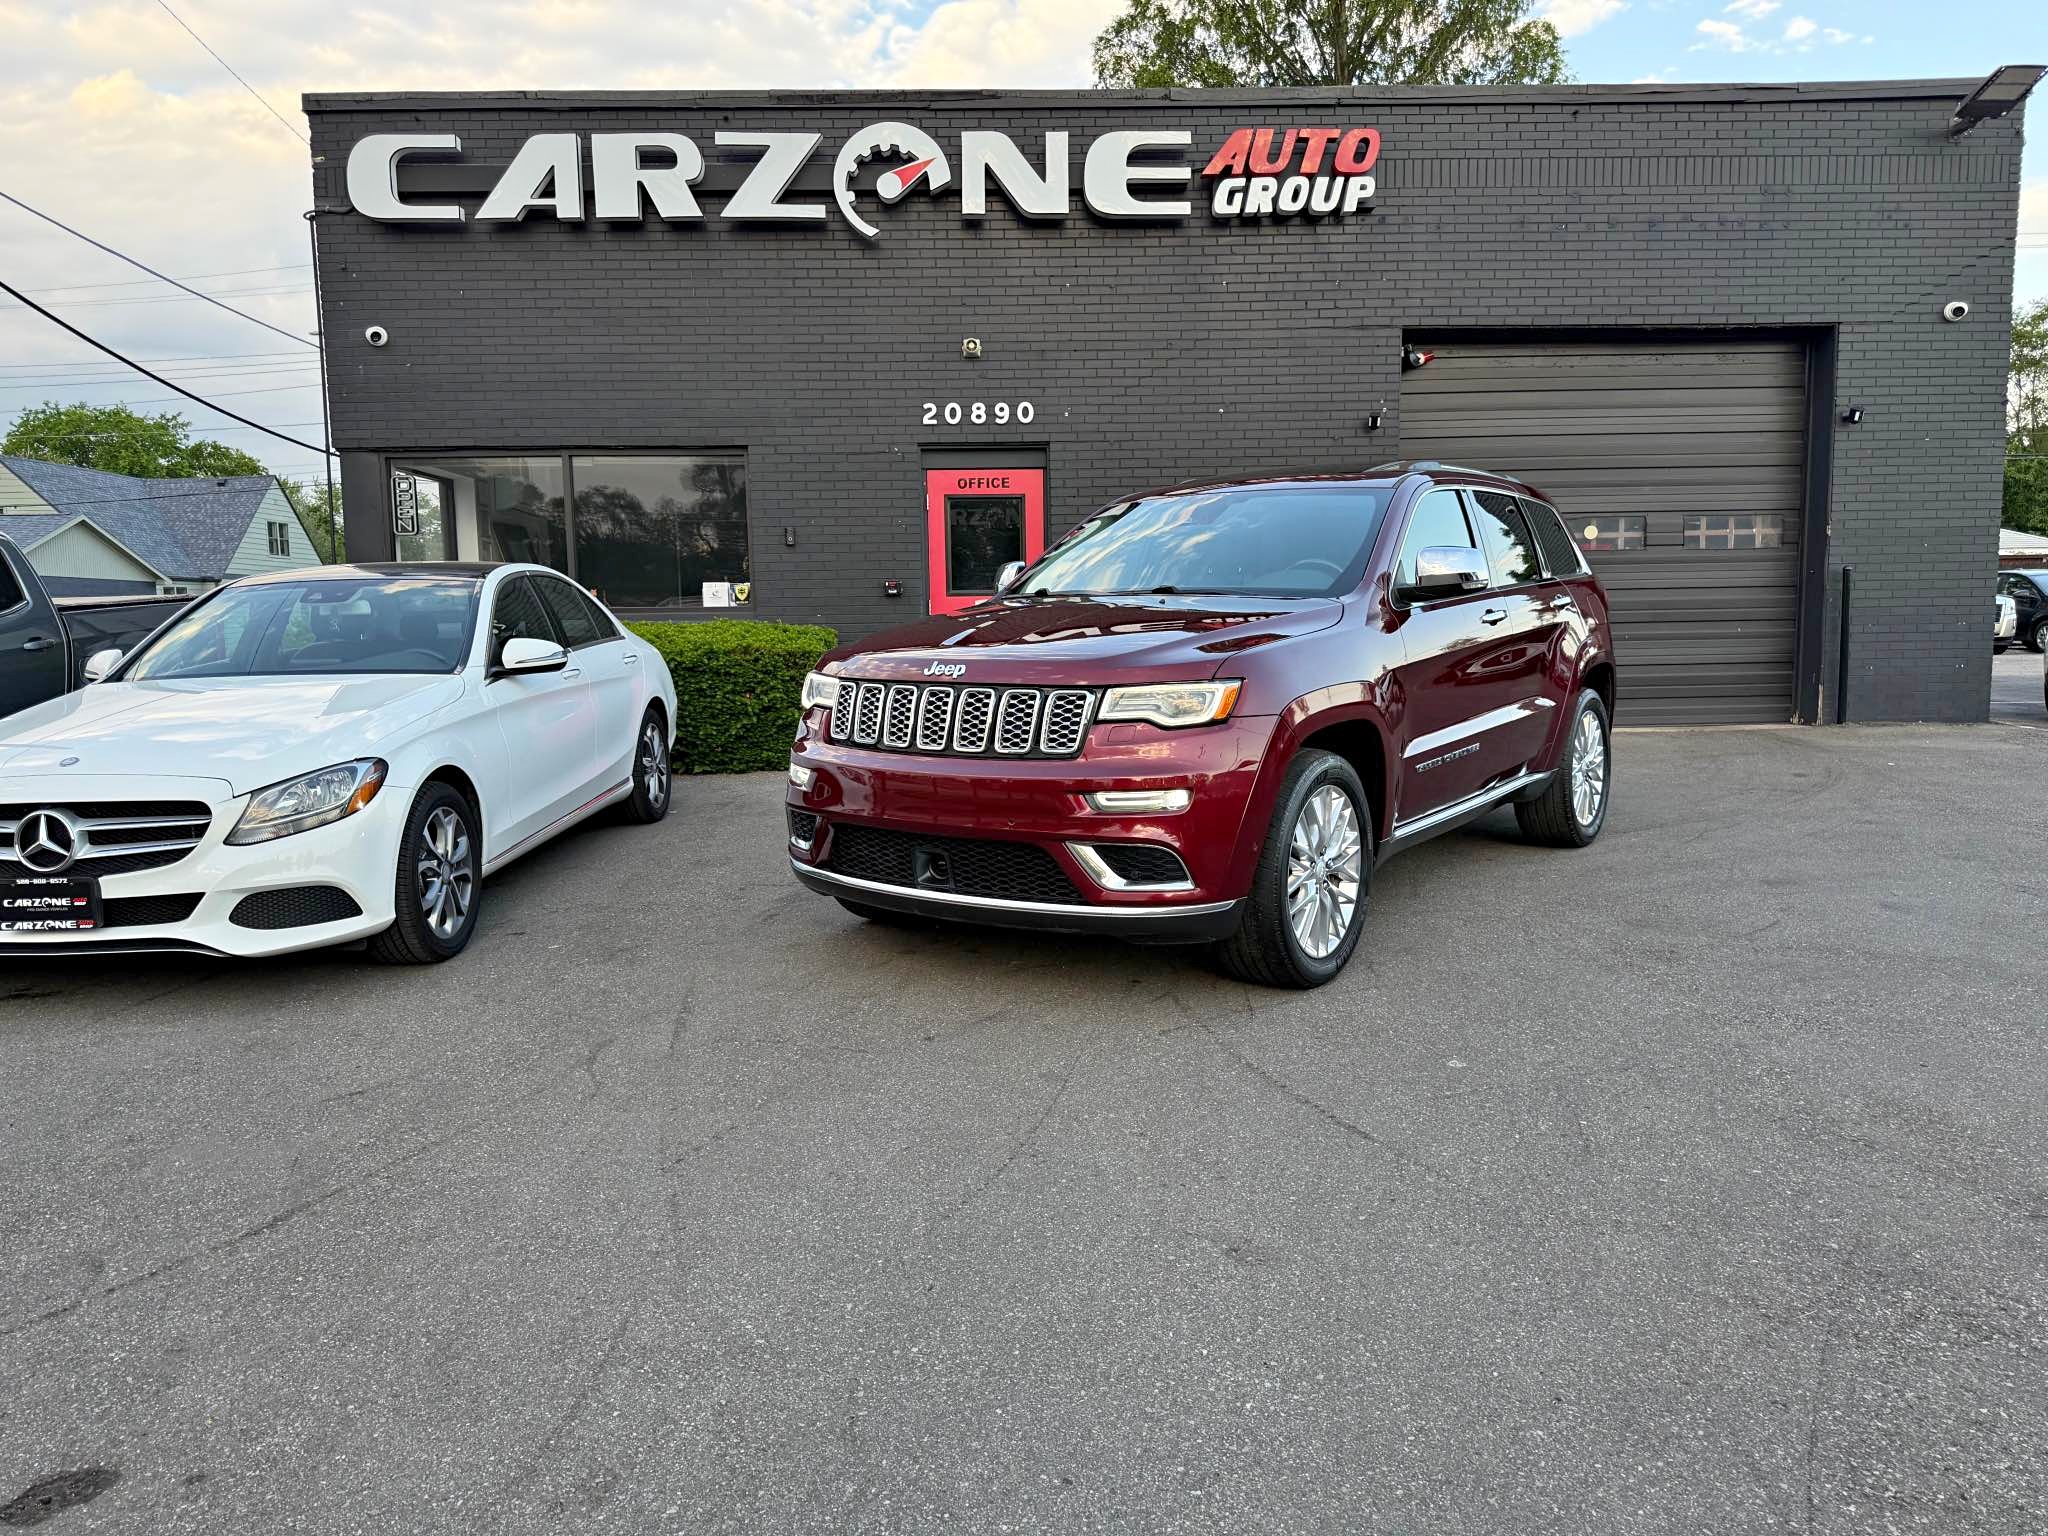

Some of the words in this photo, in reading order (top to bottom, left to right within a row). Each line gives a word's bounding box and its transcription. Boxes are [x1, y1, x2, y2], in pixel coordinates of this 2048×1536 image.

[347, 121, 1191, 238] CARZONE
[1201, 128, 1381, 177] AUTO
[1213, 176, 1377, 216] GROUP
[922, 401, 1034, 424] 20890
[957, 477, 1010, 489] OFFICE
[395, 479, 412, 532] OPEN
[923, 661, 967, 679] Jeep
[3, 897, 71, 908] CARZONE
[0, 920, 77, 930] CARZONE
